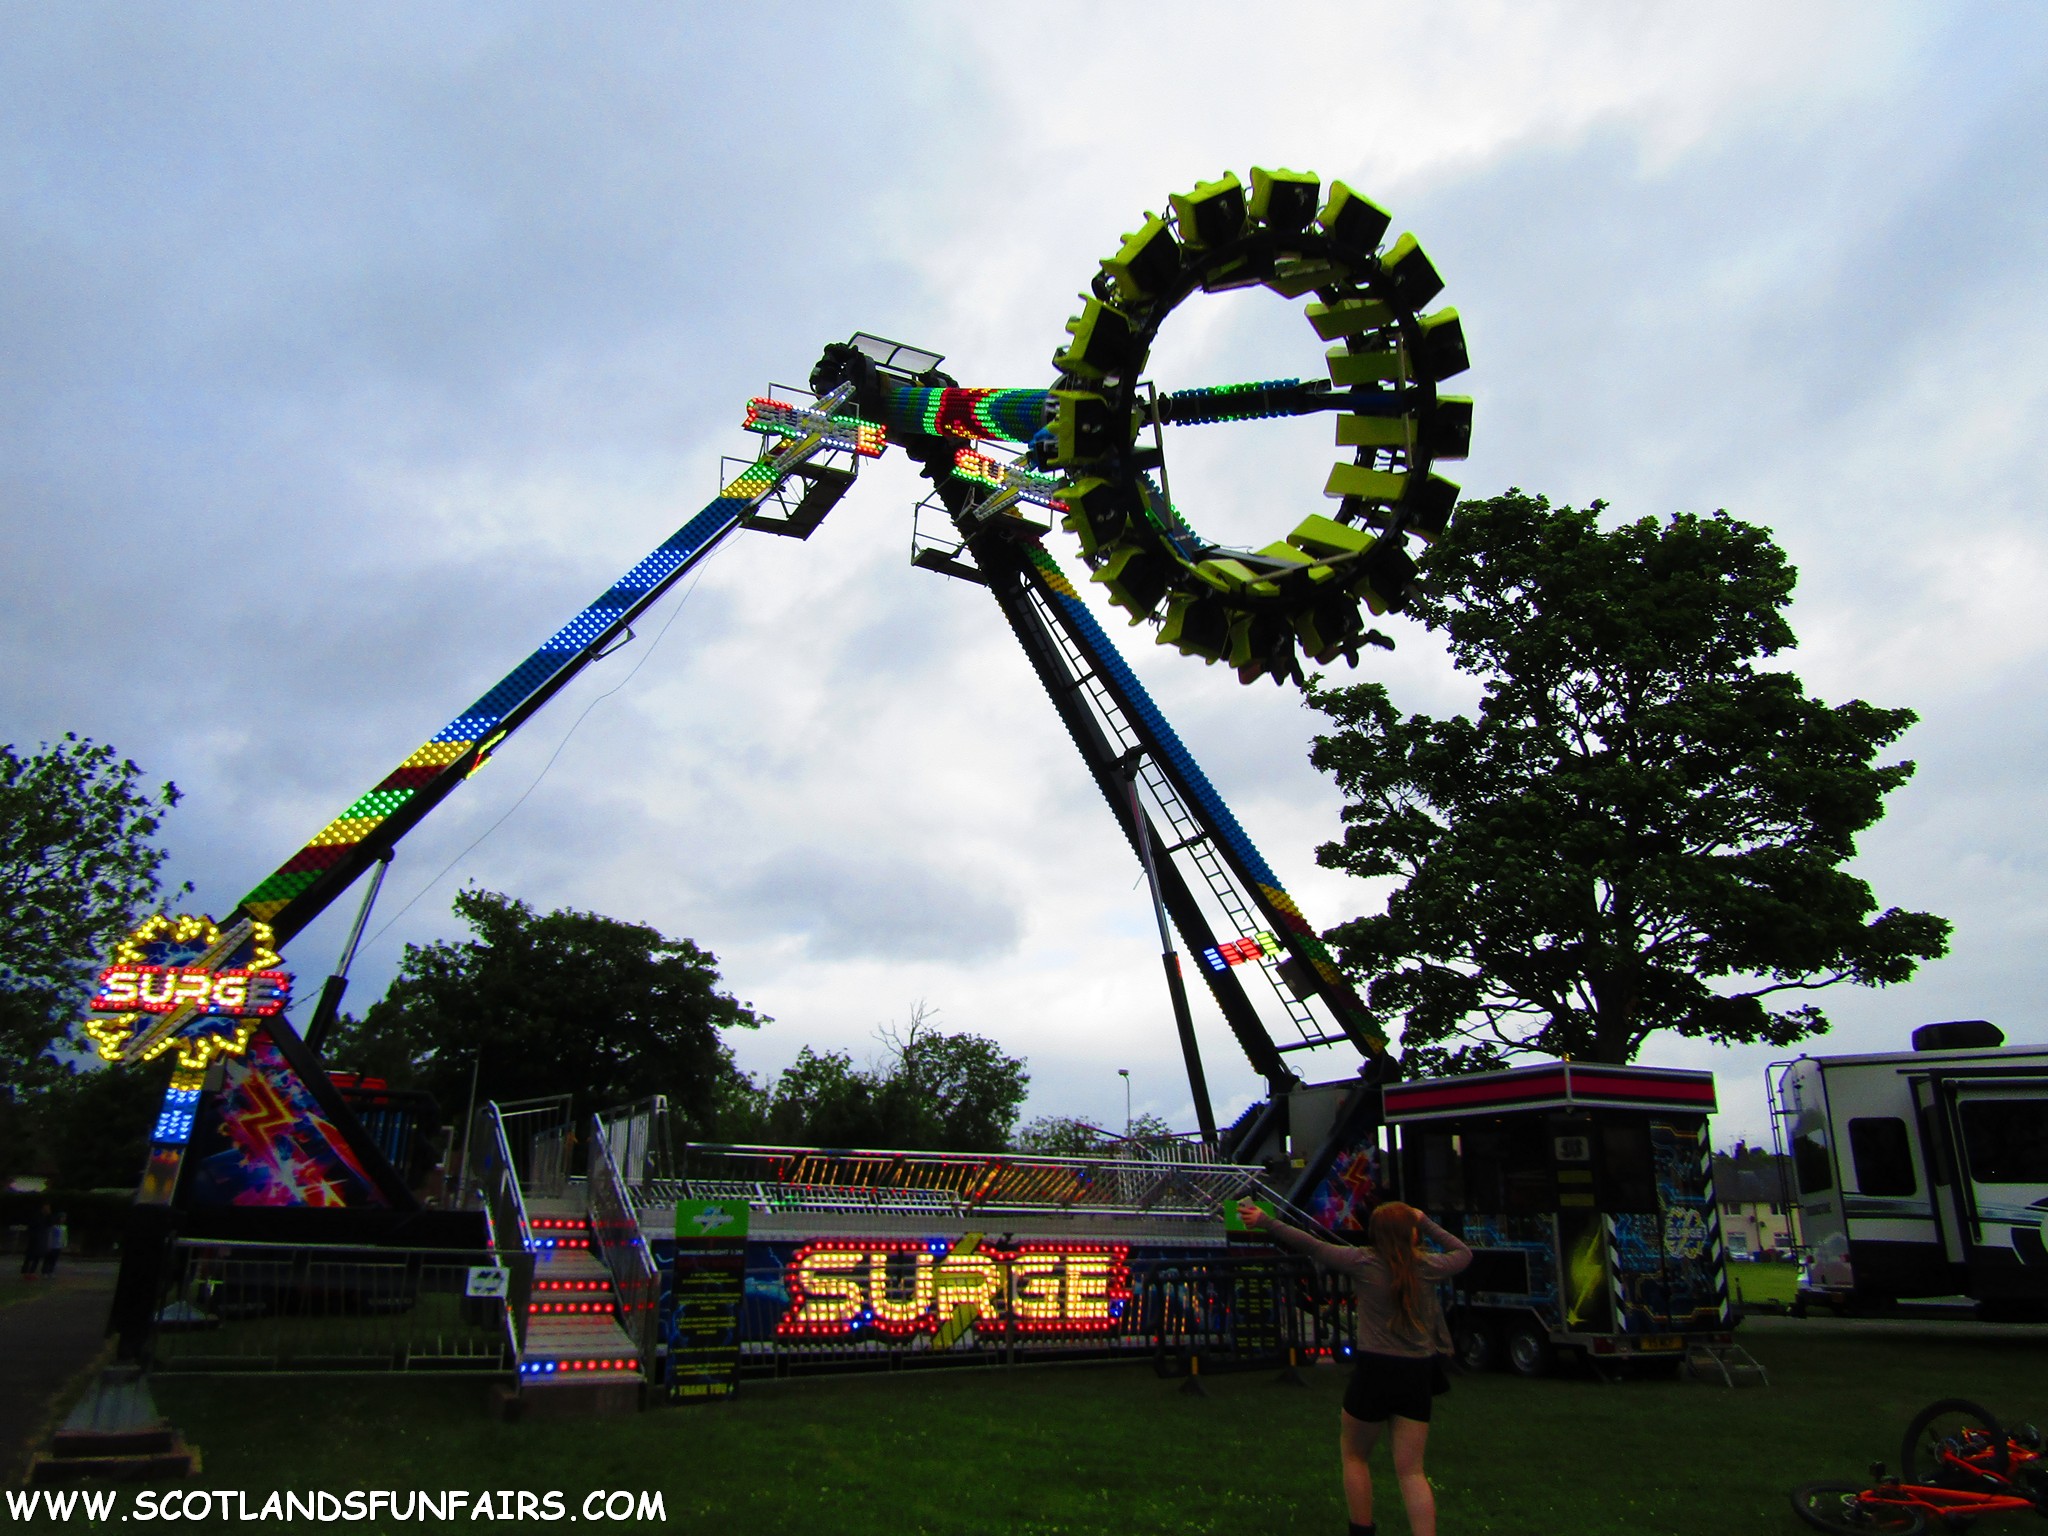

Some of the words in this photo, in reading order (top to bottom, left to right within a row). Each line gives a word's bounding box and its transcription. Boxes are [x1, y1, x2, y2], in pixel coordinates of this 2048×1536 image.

[104, 971, 278, 1008] SURGE
[797, 1252, 1112, 1321] SURGE
[679, 1384, 708, 1396] THANK
[709, 1382, 728, 1394] YOU
